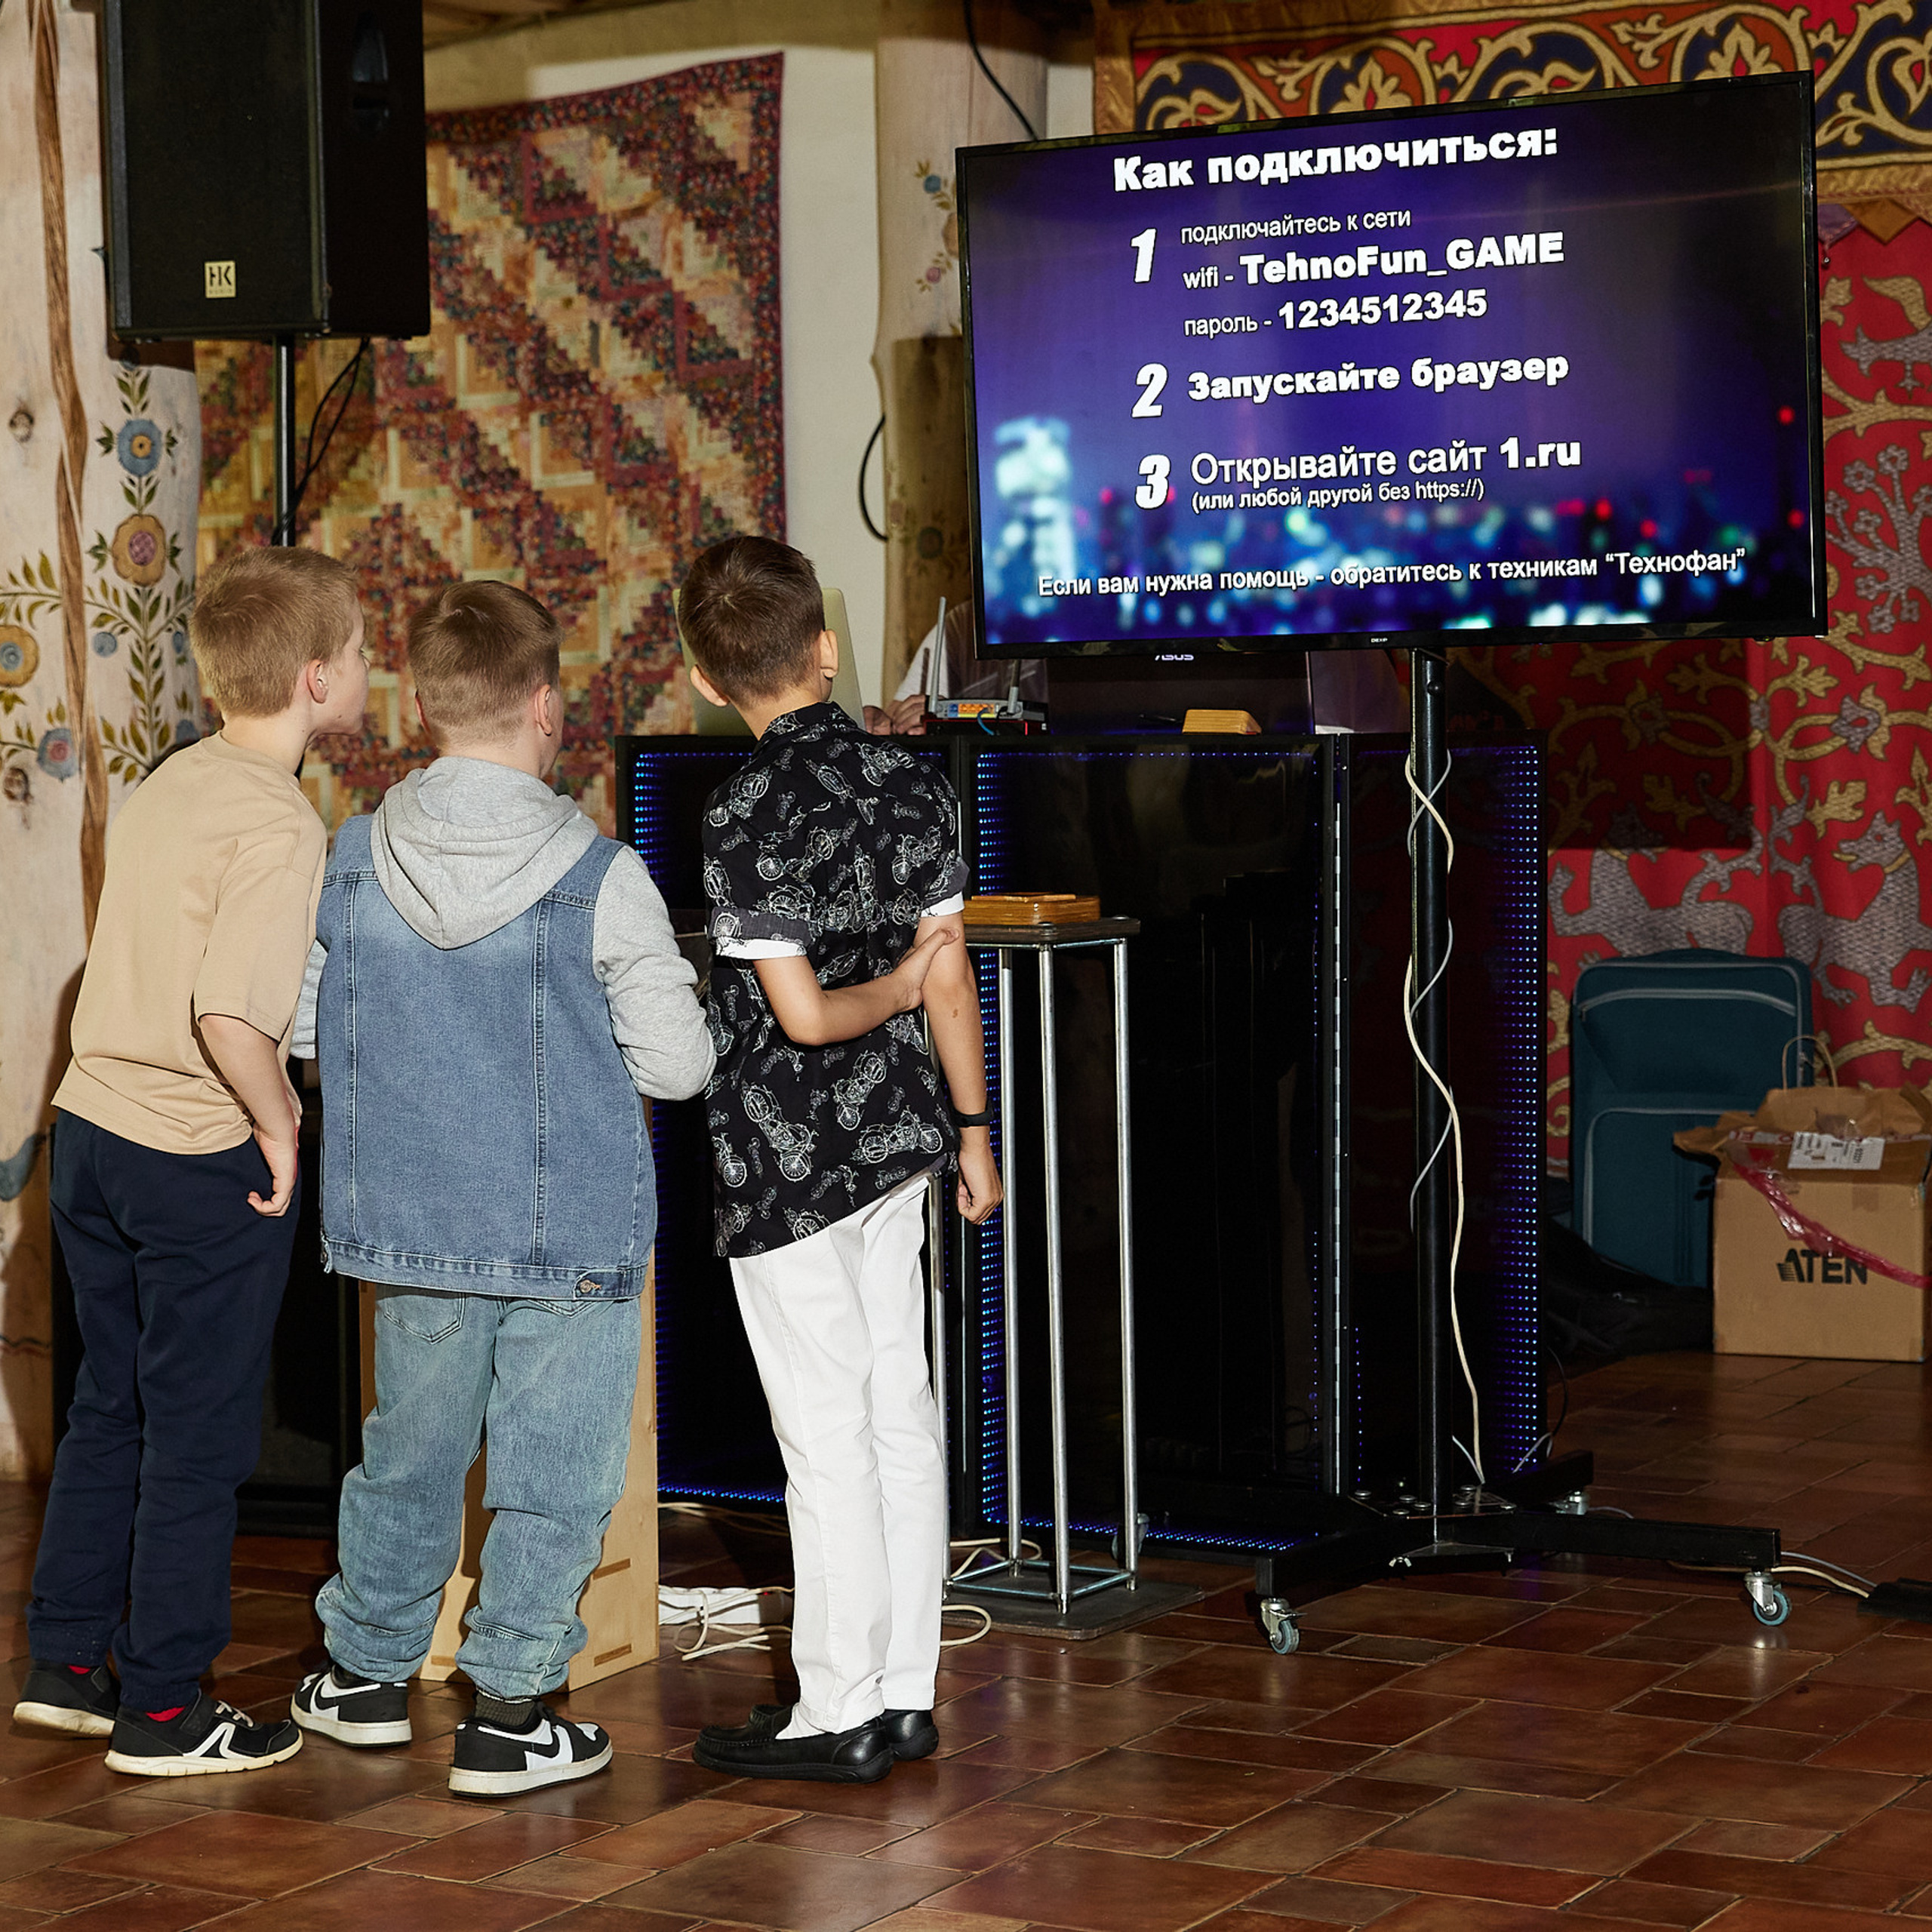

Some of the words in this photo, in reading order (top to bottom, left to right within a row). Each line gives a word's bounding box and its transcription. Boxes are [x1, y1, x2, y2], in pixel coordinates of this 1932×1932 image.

[1113, 155, 1194, 192] Как
[1208, 128, 1558, 186] подключиться:
[1131, 228, 1156, 283] 1
[1180, 214, 1341, 245] подключайтесь
[1347, 214, 1358, 231] к
[1363, 210, 1411, 229] сети
[1183, 266, 1219, 289] wifi
[1239, 232, 1564, 285] TehnoFun_GAME
[1184, 315, 1259, 340] пароль
[1278, 288, 1487, 329] 1234512345
[1131, 363, 1168, 417] 2
[1187, 362, 1400, 404] Запускайте
[1411, 356, 1570, 392] браузер
[1135, 454, 1171, 509] 3
[1191, 445, 1397, 489] Открывайте
[1407, 439, 1487, 474] сайт
[1500, 437, 1581, 469] 1.ru
[1192, 491, 1234, 514] (или
[1238, 487, 1302, 509] любой
[1307, 483, 1373, 509] другой
[1379, 482, 1411, 501] без
[1415, 478, 1484, 503] https://)
[1038, 576, 1091, 596] Если
[1098, 577, 1139, 594] вам
[1145, 573, 1214, 595] нужна
[1220, 569, 1309, 590] помощь
[1330, 563, 1463, 589] обратитесь
[1469, 563, 1481, 580] к
[1487, 555, 1598, 580] техникам
[1776, 1247, 1868, 1284] ATEN
